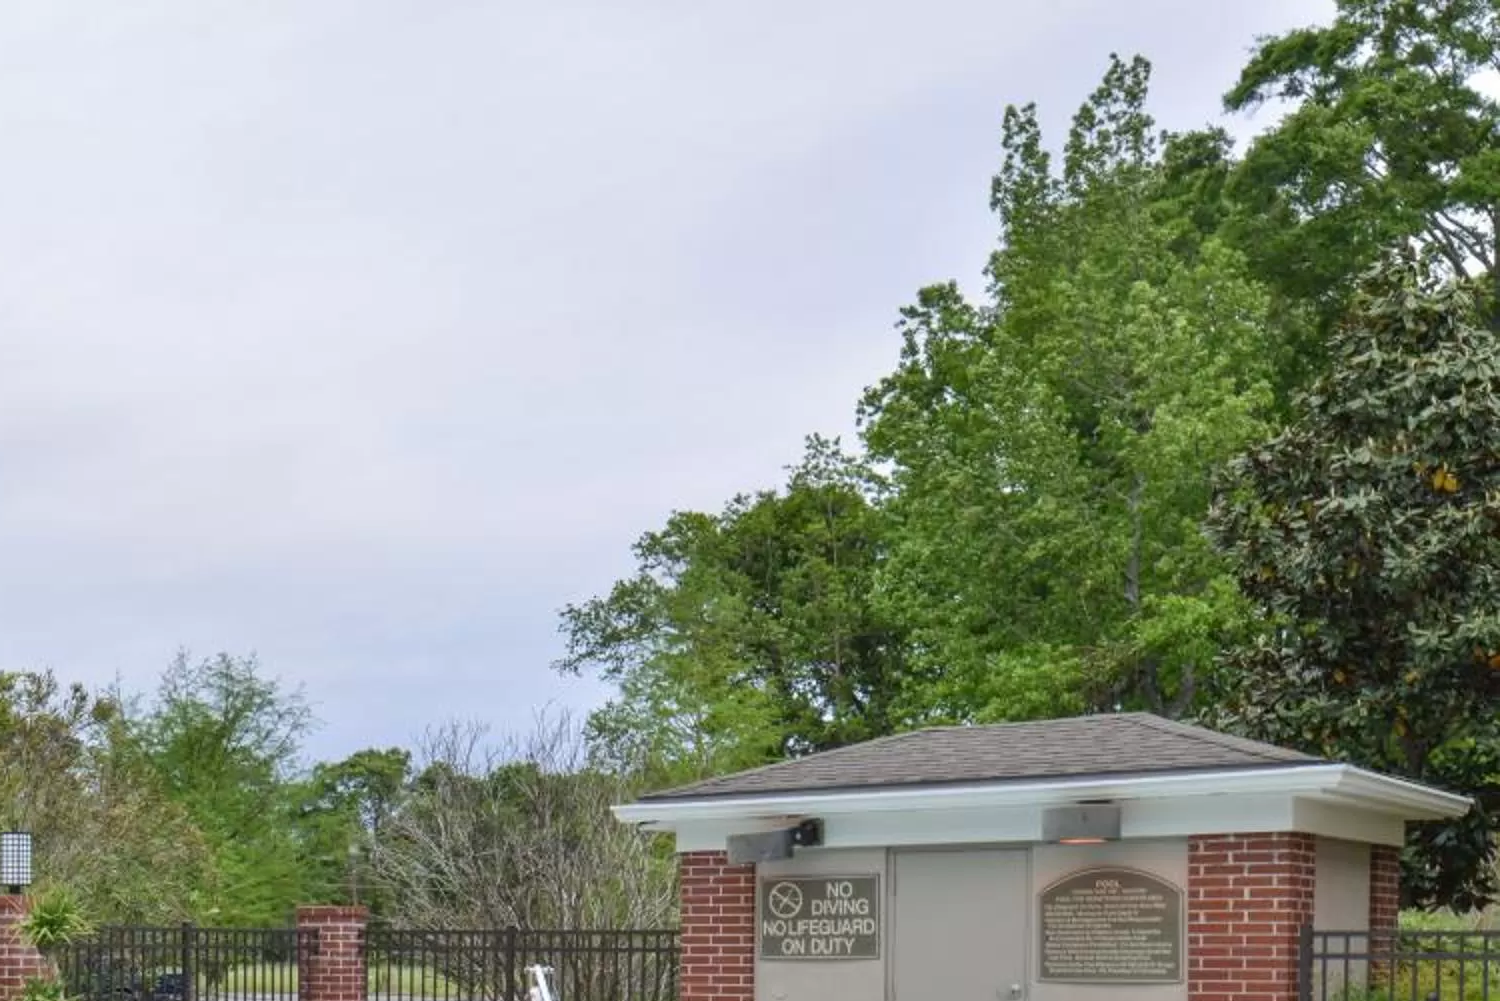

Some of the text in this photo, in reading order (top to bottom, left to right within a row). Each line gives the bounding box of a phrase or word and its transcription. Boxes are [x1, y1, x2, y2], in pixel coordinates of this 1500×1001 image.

[826, 881, 853, 898] NO
[811, 898, 869, 916] DIVING
[763, 918, 875, 936] NO LIFEGUARD
[781, 937, 856, 954] ON DUTY
